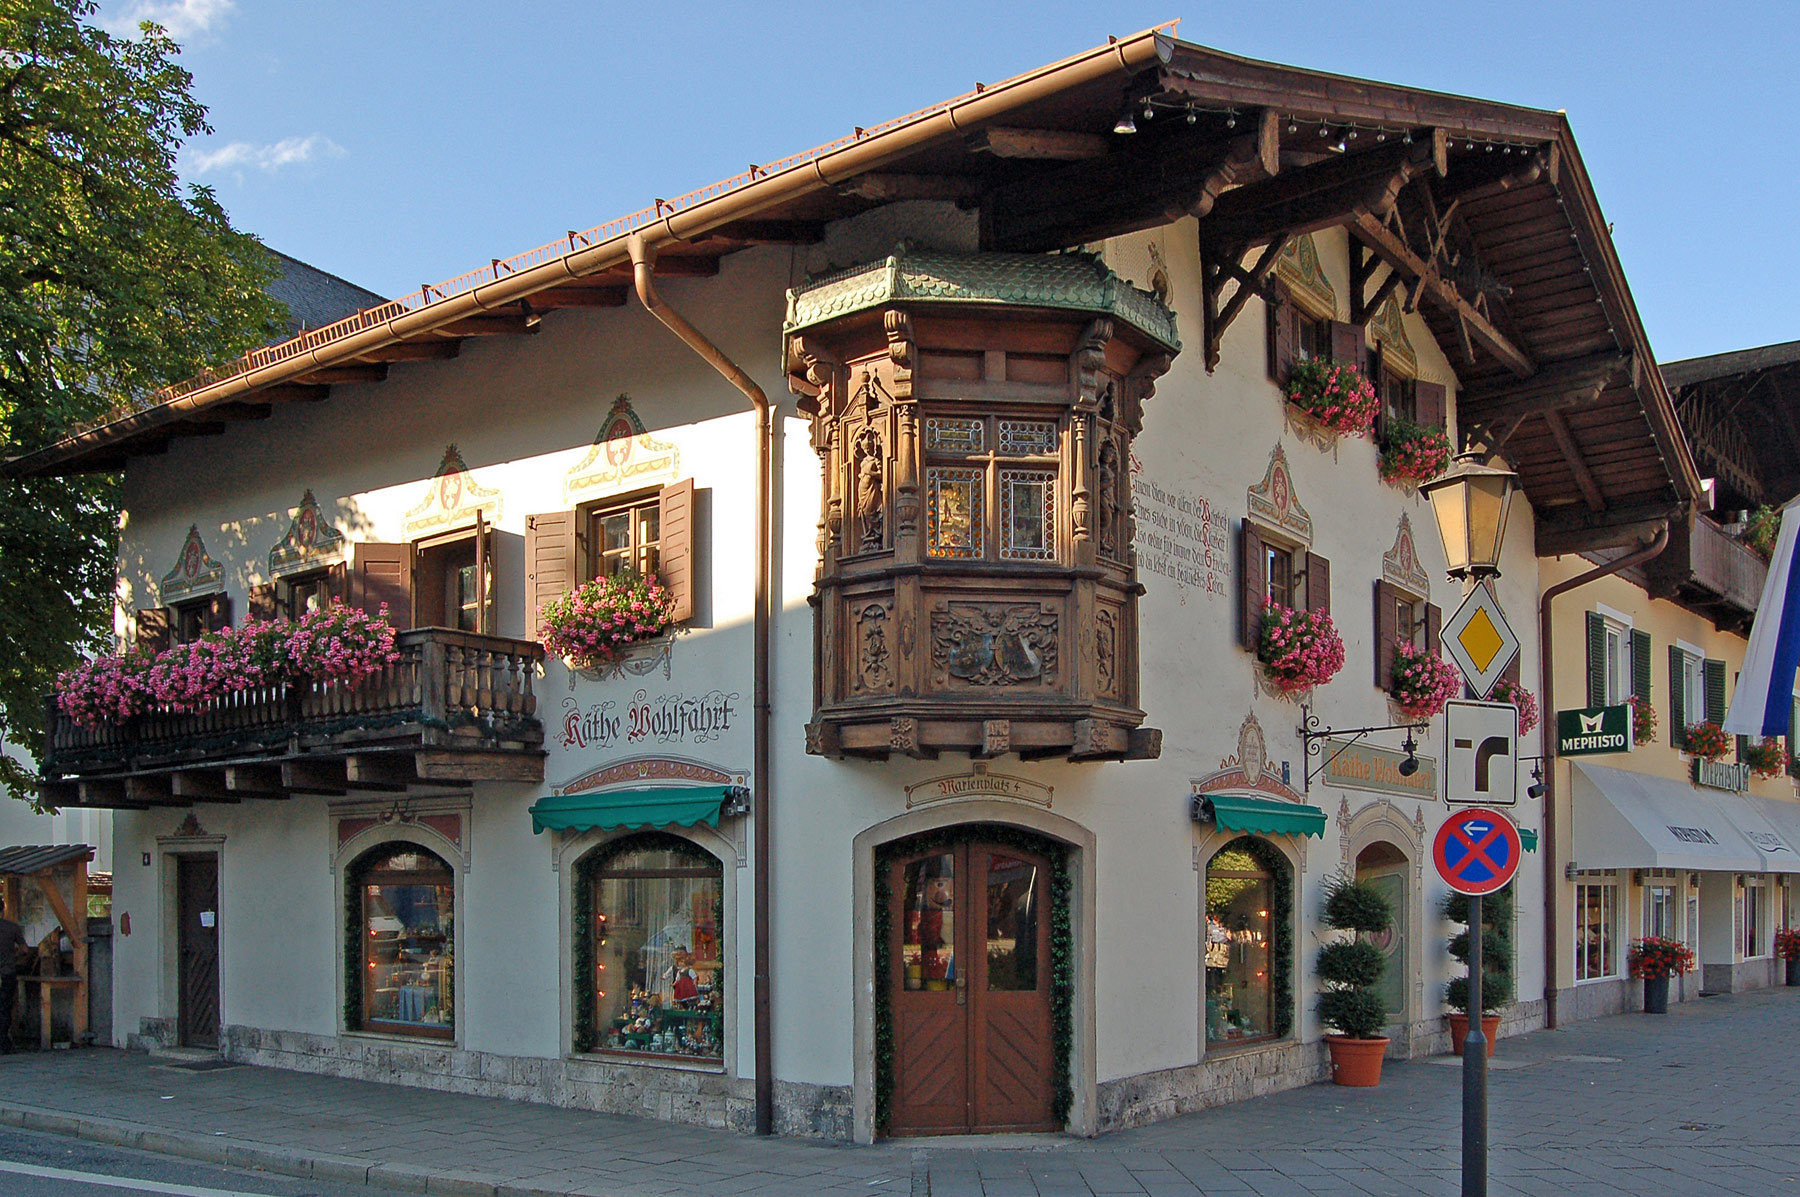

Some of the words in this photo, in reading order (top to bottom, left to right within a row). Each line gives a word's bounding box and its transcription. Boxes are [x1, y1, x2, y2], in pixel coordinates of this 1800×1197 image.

[560, 698, 621, 750] Käthe
[627, 690, 738, 743] Wohlfahrt
[1562, 734, 1624, 751] MEPHISTO
[1330, 749, 1371, 780] Käthe
[938, 778, 1010, 794] Marienplatz
[1014, 782, 1021, 792] 4
